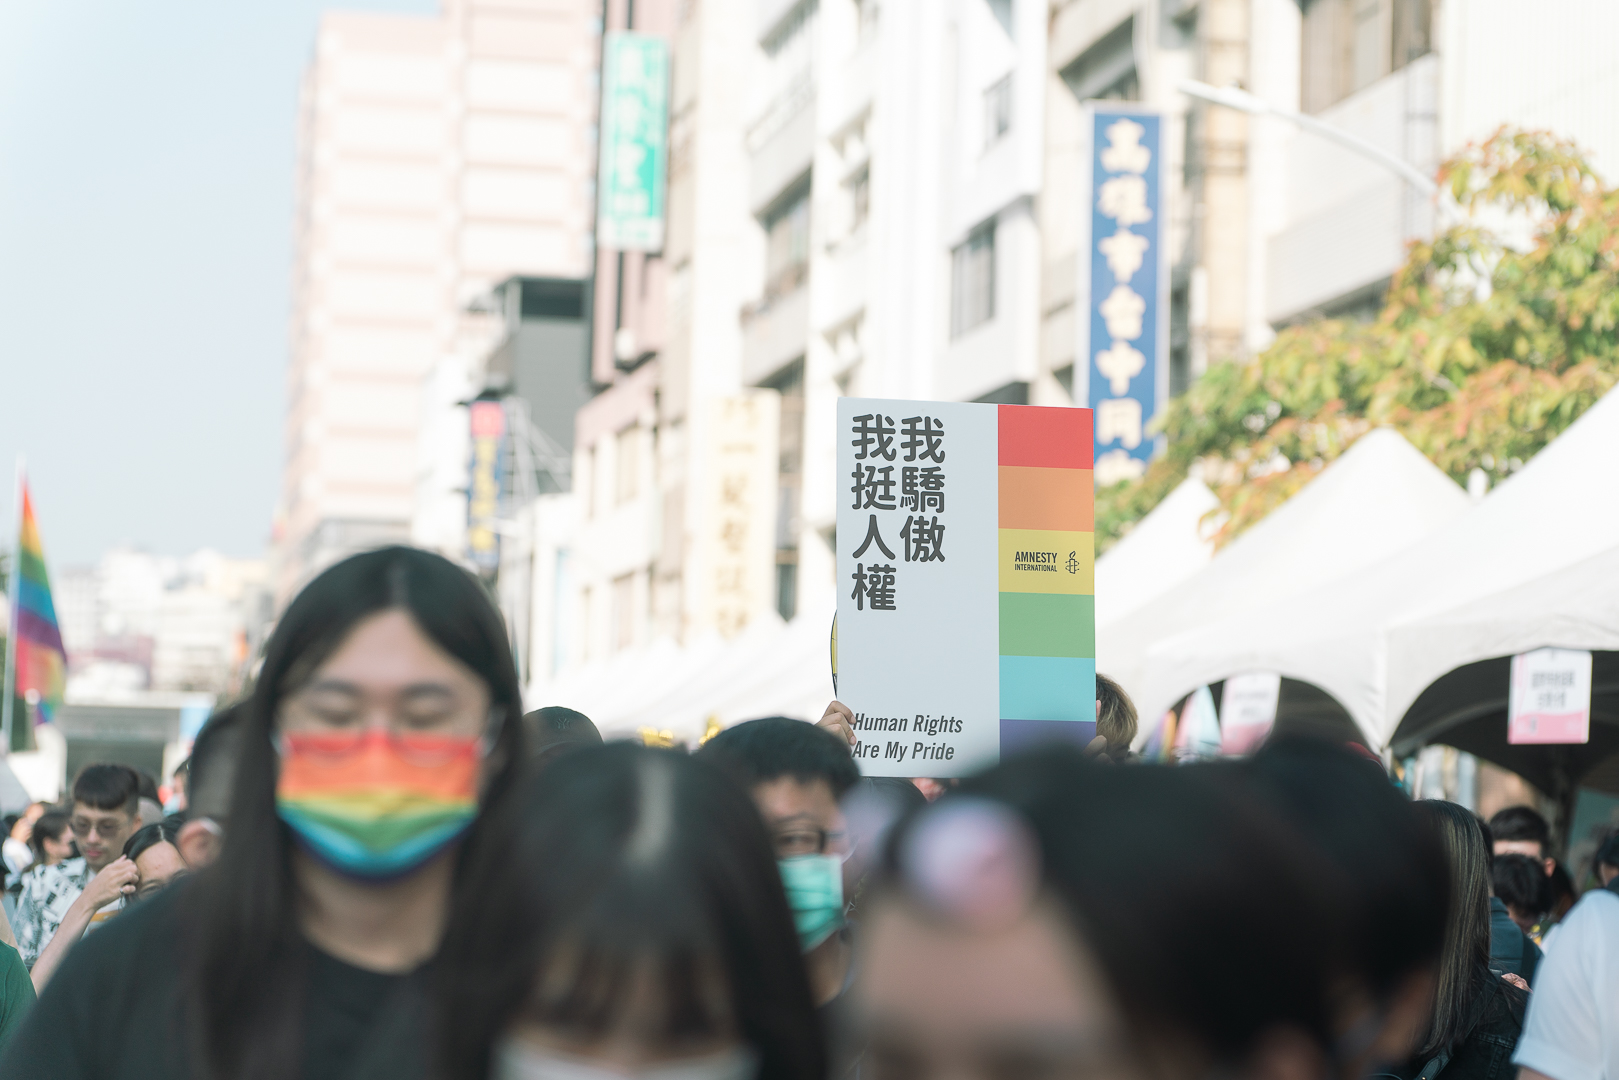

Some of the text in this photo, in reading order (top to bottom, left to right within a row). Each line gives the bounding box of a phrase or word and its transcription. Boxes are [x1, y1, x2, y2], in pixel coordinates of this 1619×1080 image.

[900, 416, 945, 562] 我驕傲
[851, 413, 897, 611] 我挺人權
[1015, 551, 1058, 563] AMNESTY
[1015, 564, 1057, 572] INTERNATIONAL
[853, 713, 963, 736] Human Rights
[852, 741, 955, 762] Are My Pride
